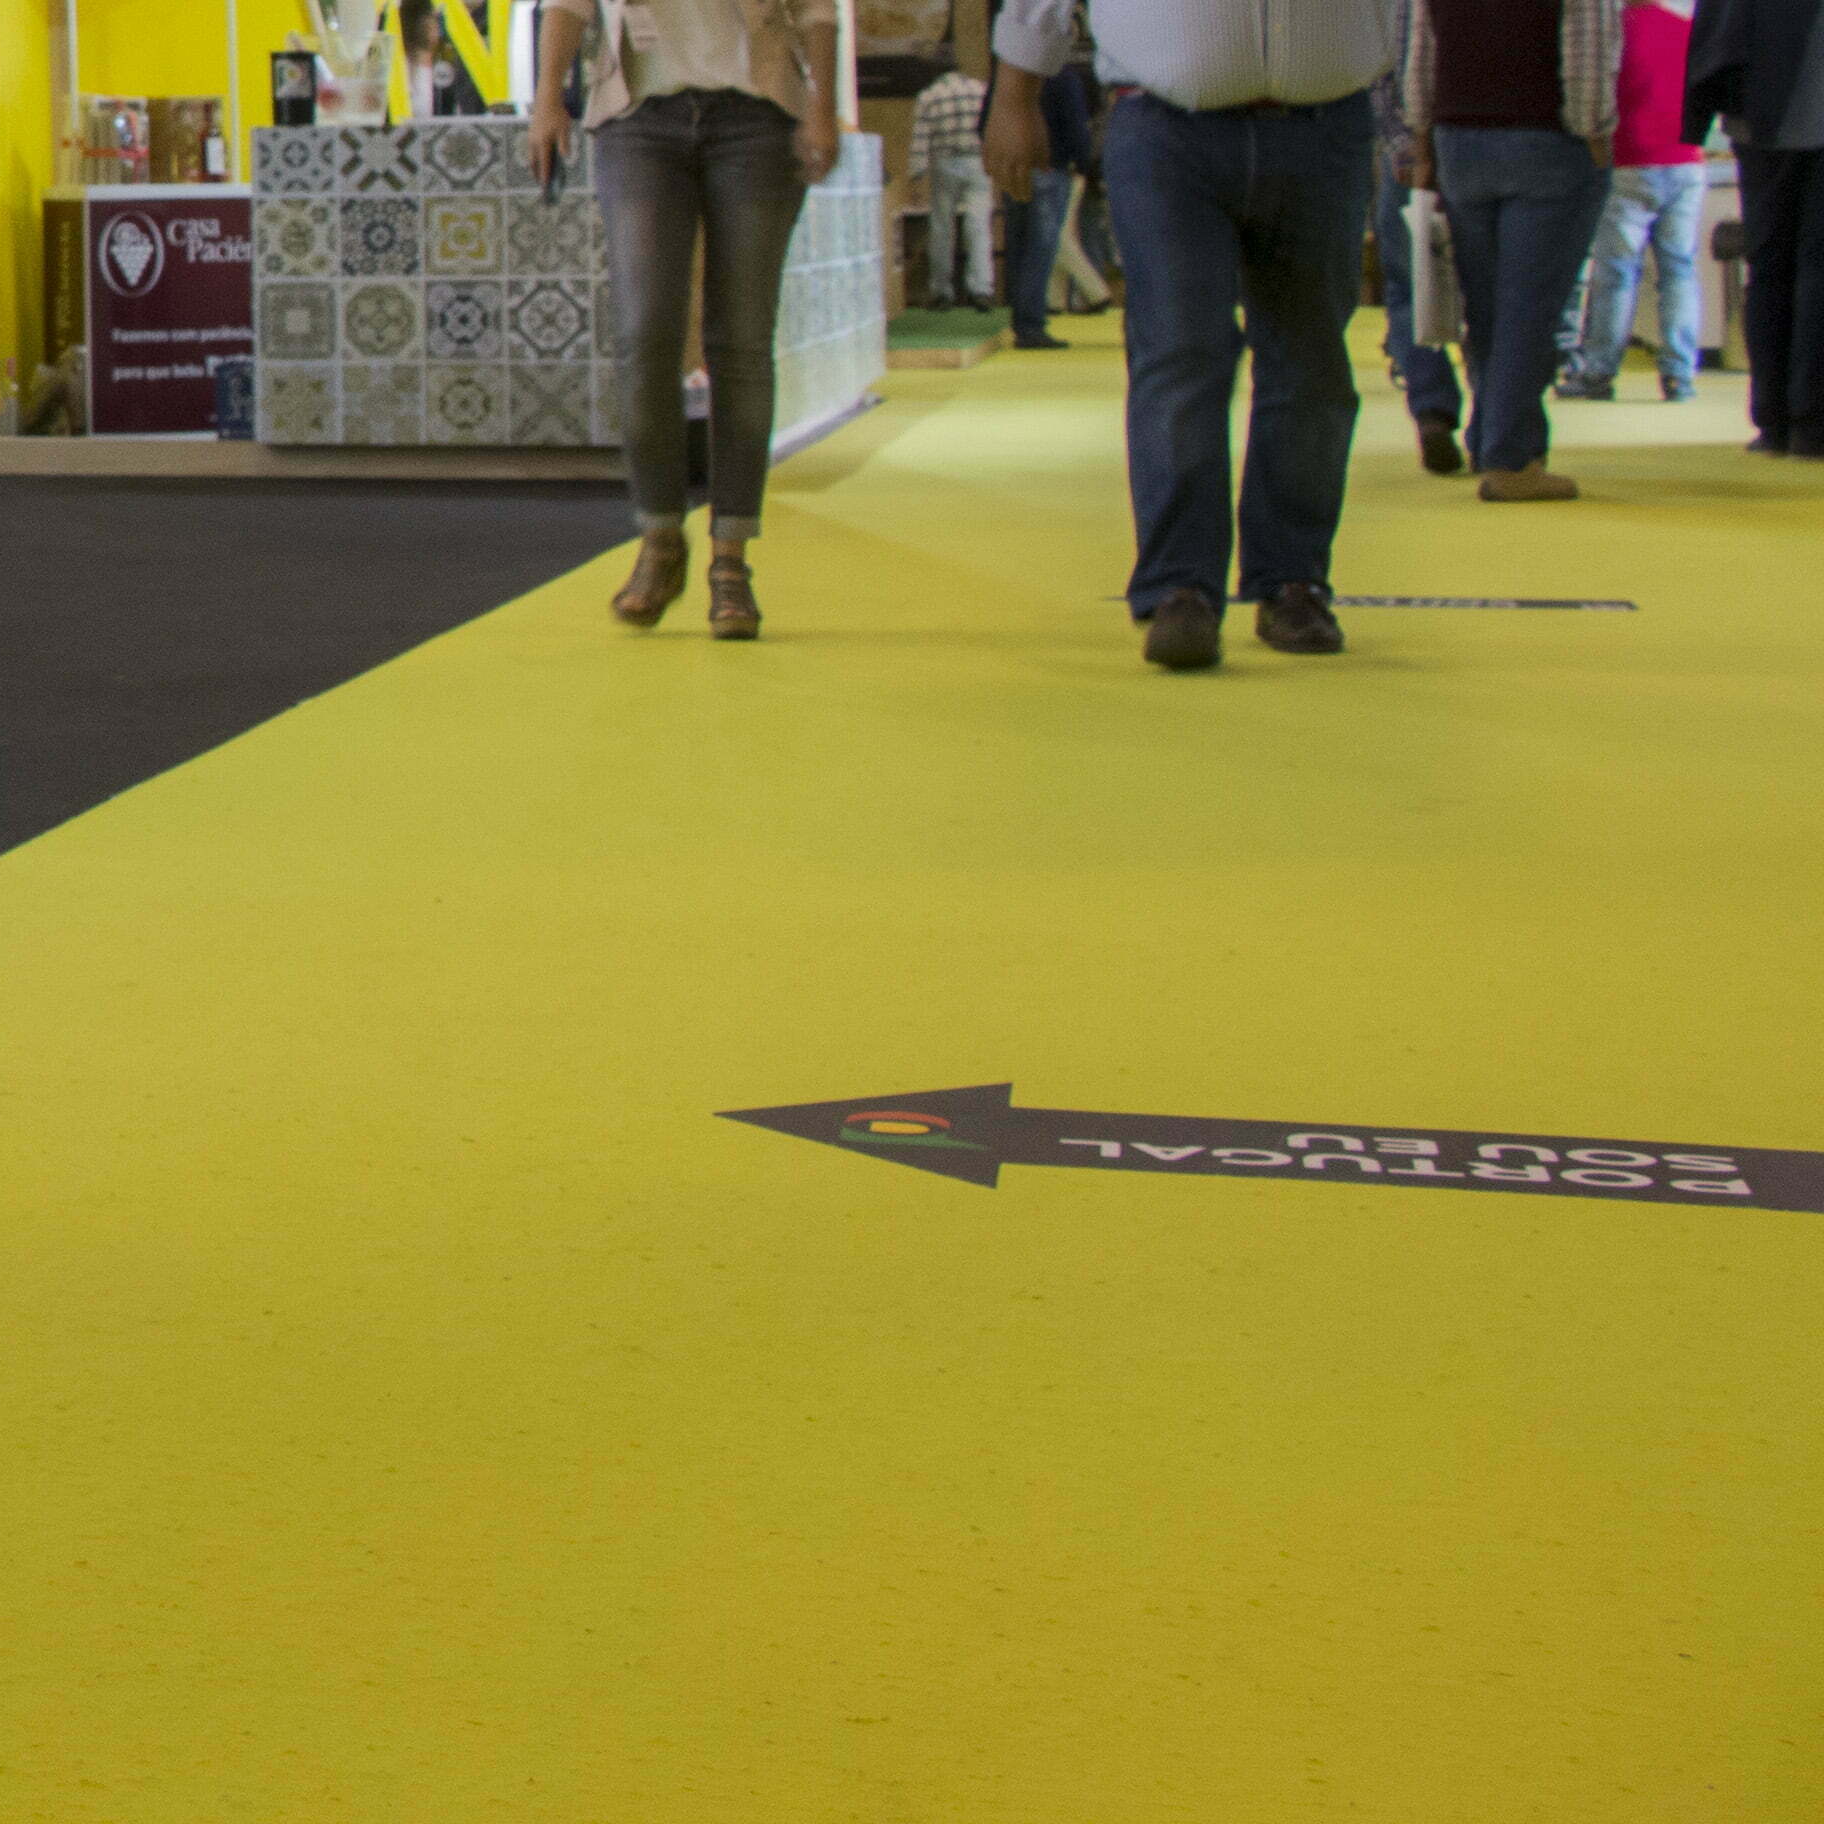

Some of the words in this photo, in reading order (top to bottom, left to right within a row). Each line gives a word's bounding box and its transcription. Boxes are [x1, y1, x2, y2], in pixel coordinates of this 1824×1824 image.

[166, 218, 220, 247] Casa
[1286, 1131, 1440, 1156] EU
[1478, 1143, 1739, 1173] SOU
[1059, 1137, 1752, 1195] PORTUGAL
